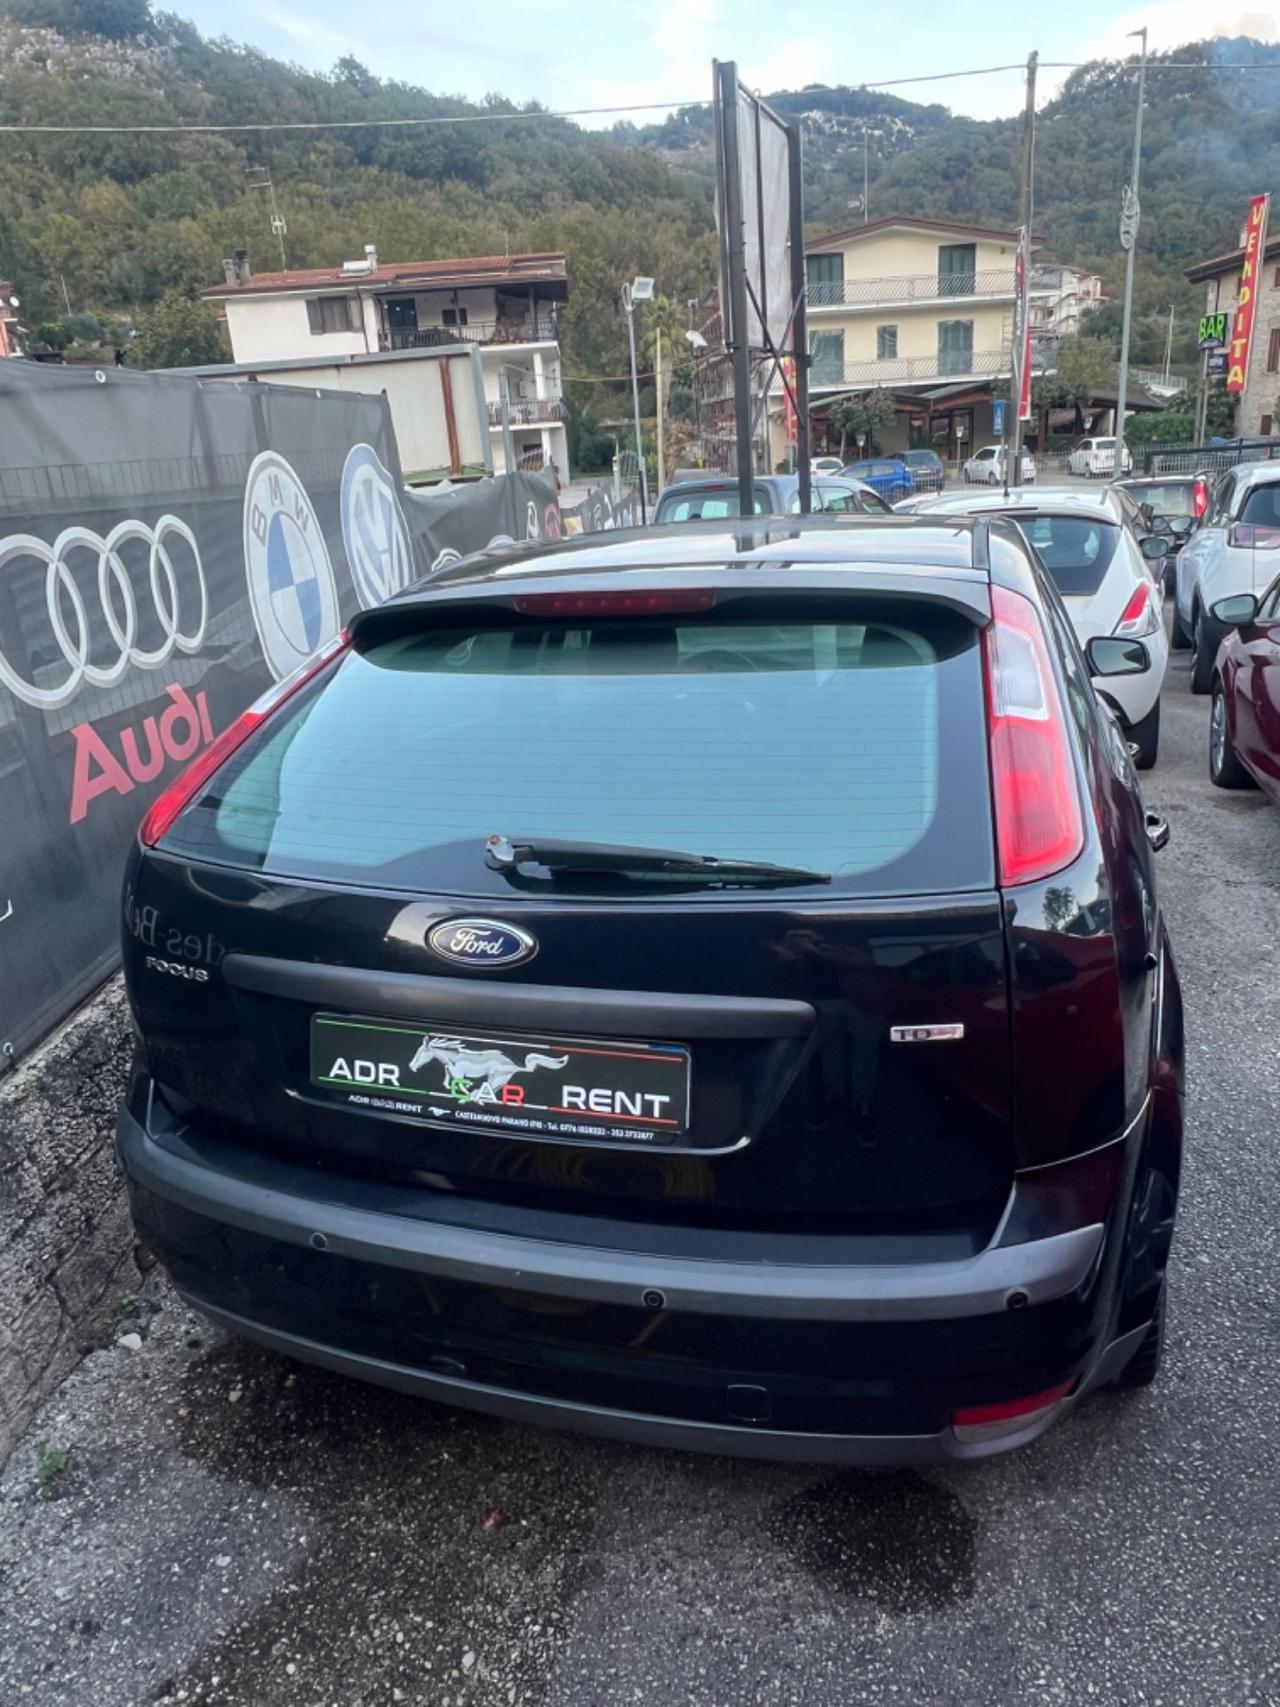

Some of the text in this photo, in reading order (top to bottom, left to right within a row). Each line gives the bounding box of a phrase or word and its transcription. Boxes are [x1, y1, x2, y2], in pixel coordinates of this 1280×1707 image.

[1227, 203, 1265, 385] VENDITA
[1199, 315, 1225, 344] BAR
[69, 681, 217, 825] Audi
[450, 927, 504, 955] Ford
[145, 955, 210, 982] FOCUS
[328, 1057, 671, 1119] ADR CAR RENT
[396, 1102, 423, 1113] RENT
